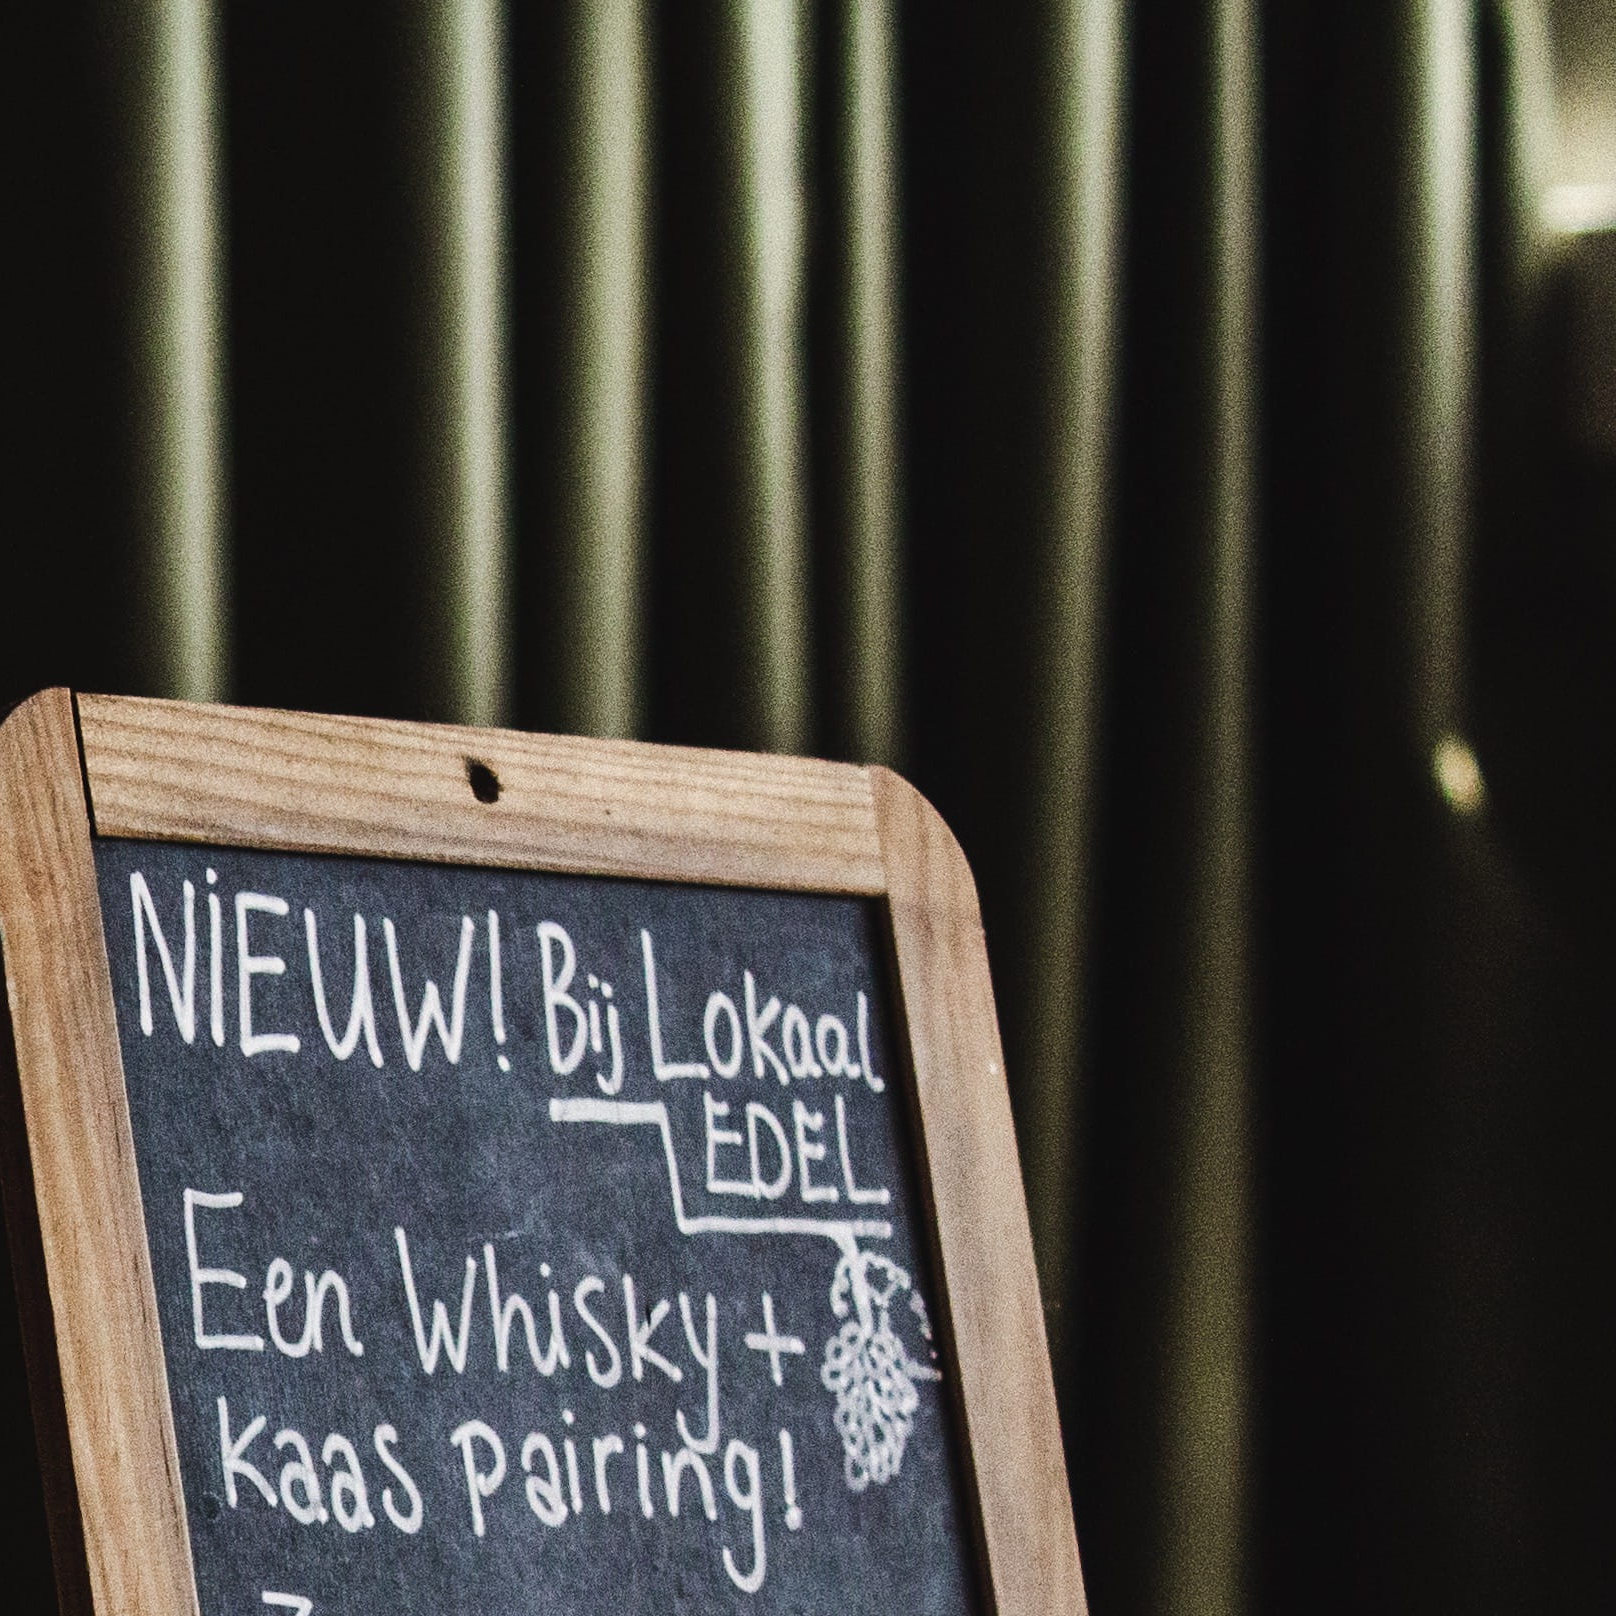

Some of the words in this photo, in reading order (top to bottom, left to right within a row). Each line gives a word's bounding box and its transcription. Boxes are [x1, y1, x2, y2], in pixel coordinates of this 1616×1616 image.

[538, 920, 625, 1095] Bij
[703, 1090, 891, 1204] EDEL
[183, 1188, 364, 1359] Een
[394, 1226, 722, 1456] Whisky
